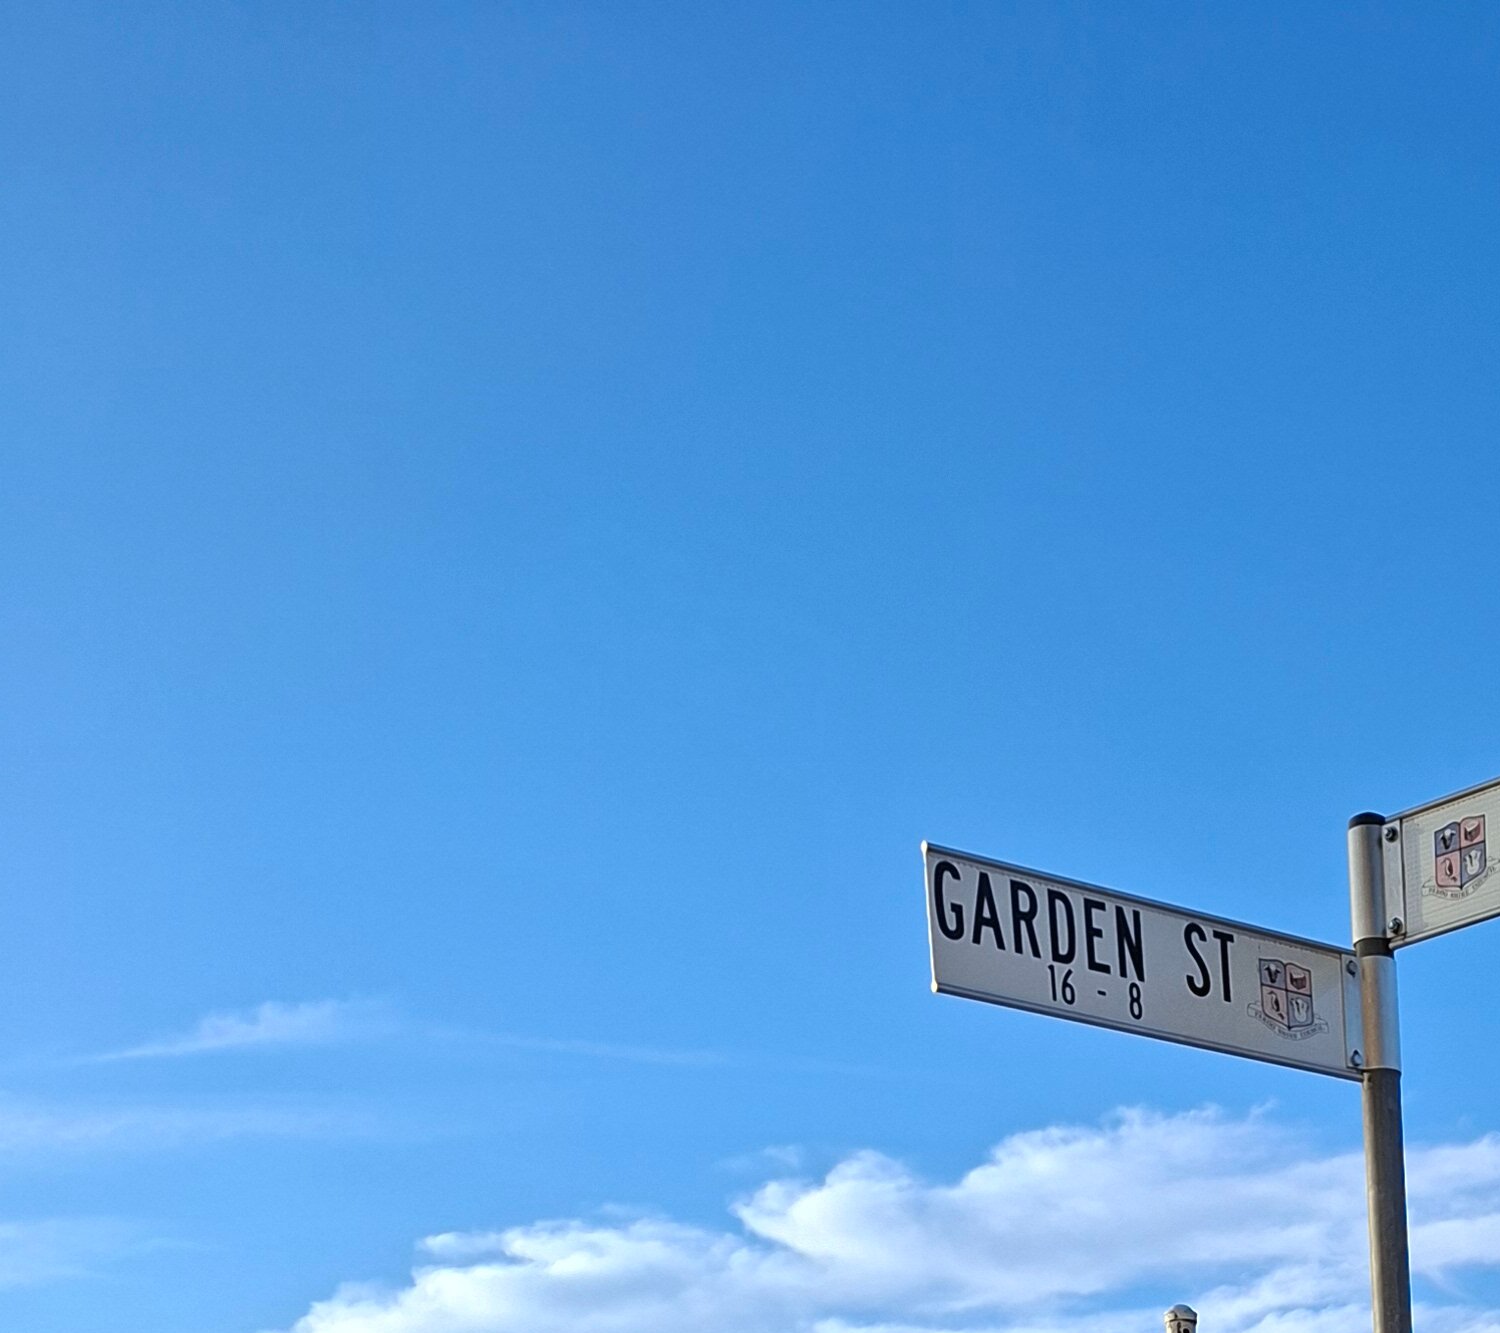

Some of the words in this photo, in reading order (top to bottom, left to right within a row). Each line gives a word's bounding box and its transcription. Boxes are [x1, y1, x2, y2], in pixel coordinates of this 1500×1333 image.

[932, 860, 1146, 983] GARDEN
[1183, 922, 1235, 1003] ST
[1047, 963, 1076, 1006] 16
[1128, 982, 1144, 1021] 8
